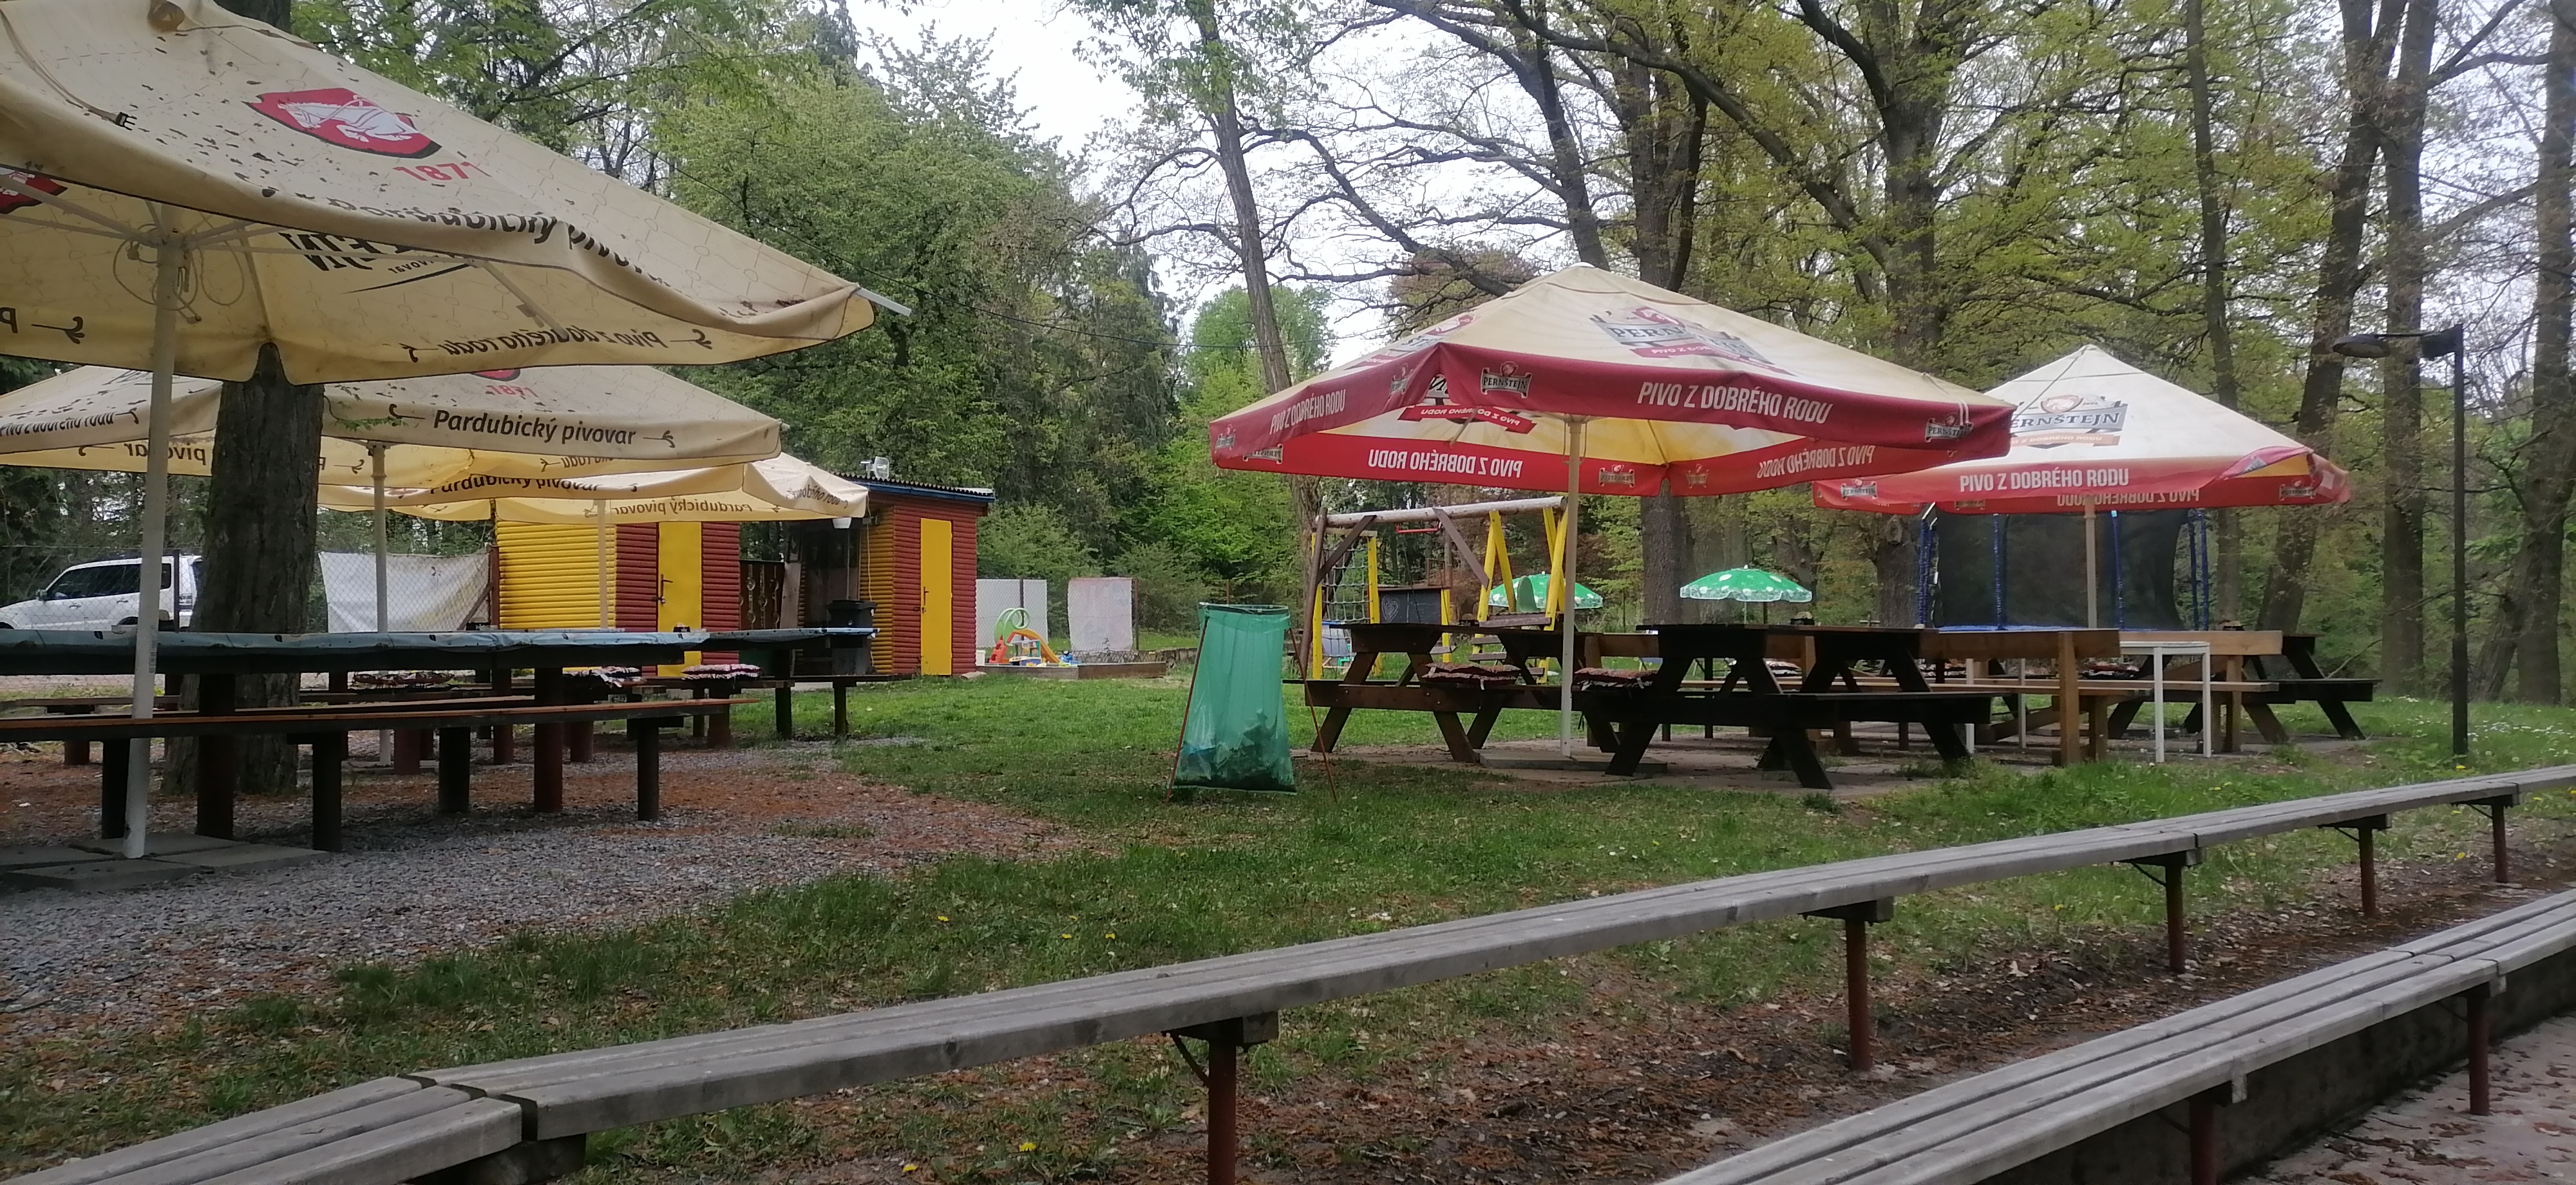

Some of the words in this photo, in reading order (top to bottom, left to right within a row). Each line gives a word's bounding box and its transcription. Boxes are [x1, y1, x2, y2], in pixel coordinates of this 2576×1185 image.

[392, 162, 492, 181] 1871
[1483, 377, 1527, 389] PERNŠTEJN
[1285, 407, 1291, 428] Z
[1291, 393, 1324, 426] DOBRÉHO
[1325, 388, 1346, 416] RODU
[1637, 381, 1682, 406] PIVO
[1683, 384, 1699, 408] Z
[1701, 385, 1782, 417] DOBRÉHO
[1783, 395, 1833, 424] RODU
[433, 409, 558, 443] Pardubický
[561, 420, 637, 445] pivovar
[2011, 413, 2120, 428] ERNŠTEJN
[1960, 474, 1994, 492] PIVO
[1997, 473, 2007, 490] Z
[2010, 466, 2083, 490] DOBRÉHO
[2087, 468, 2129, 488] RODU
